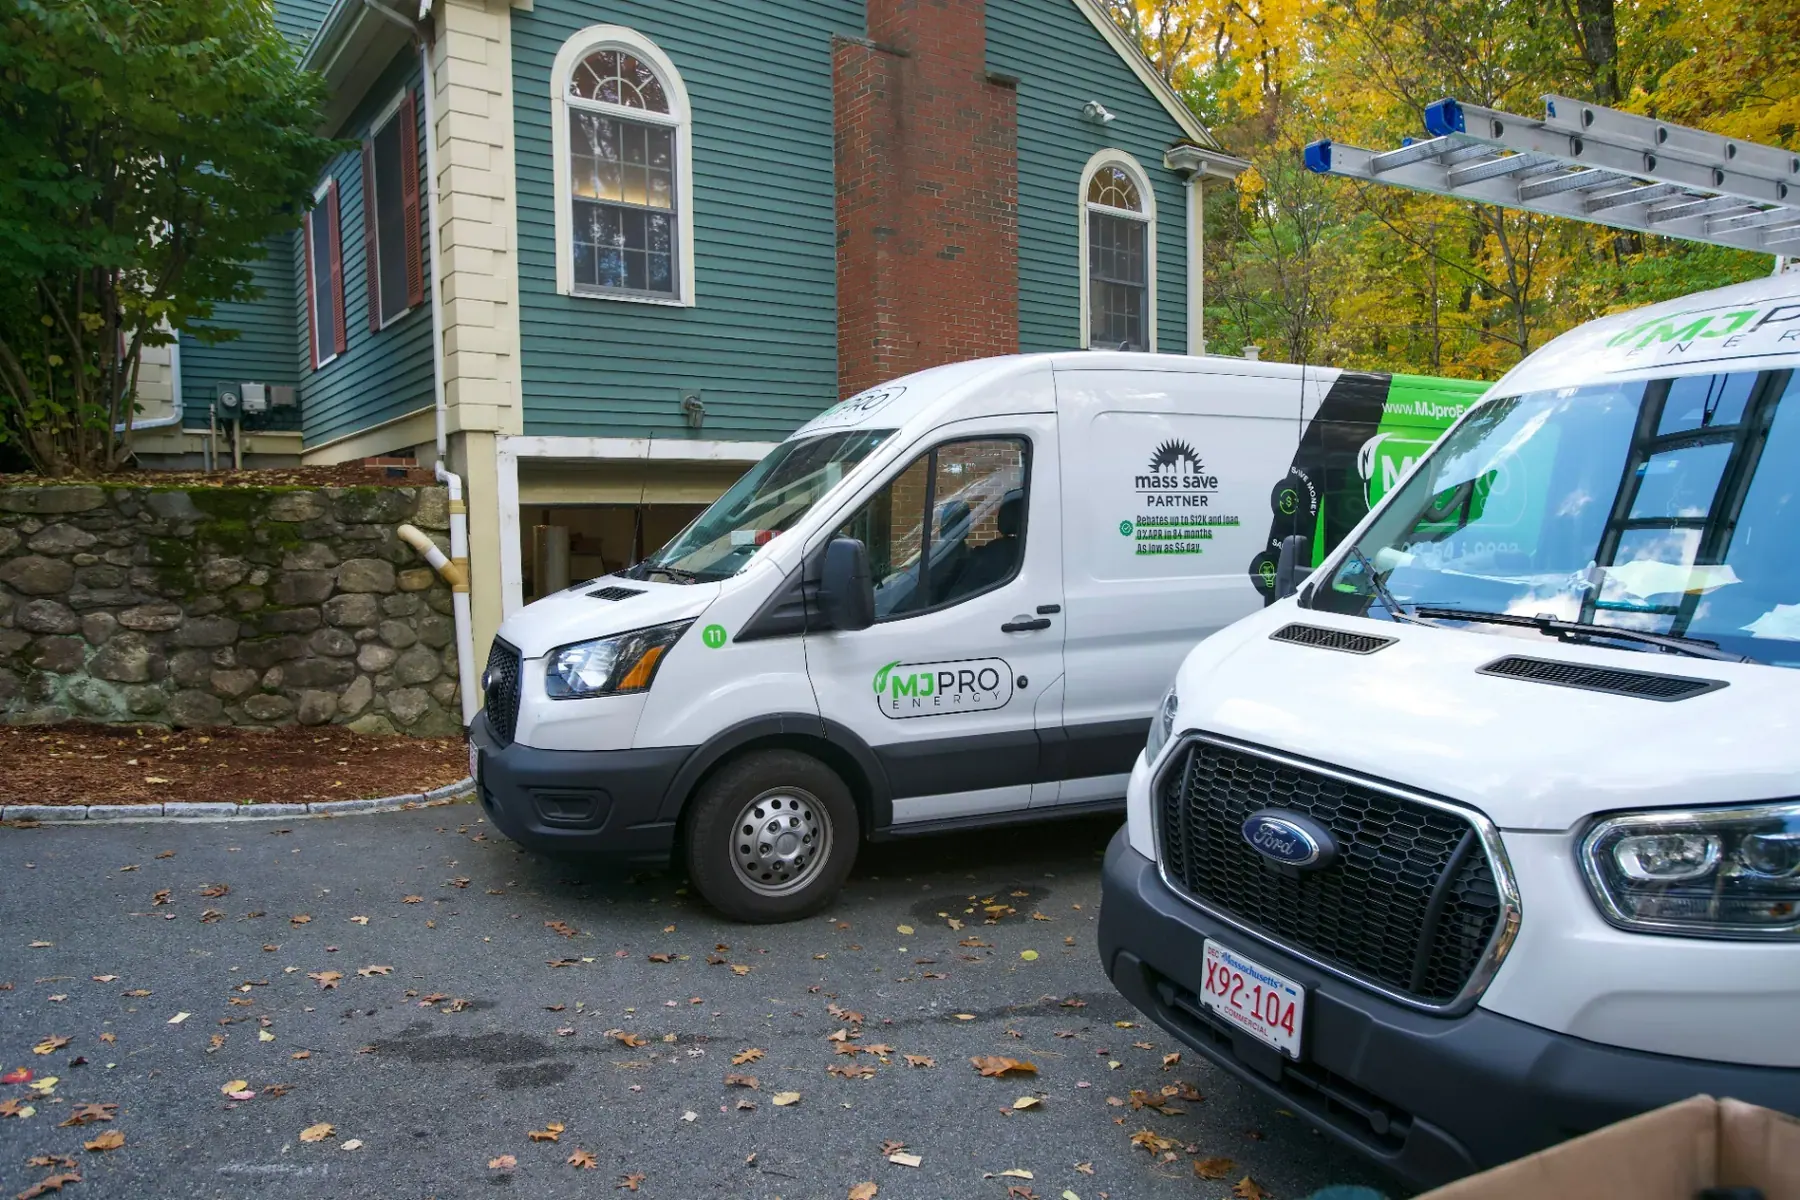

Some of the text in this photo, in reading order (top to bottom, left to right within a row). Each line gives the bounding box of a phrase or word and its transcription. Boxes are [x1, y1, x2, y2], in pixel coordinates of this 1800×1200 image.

[1381, 401, 1468, 420] www.MJproE
[1135, 475, 1219, 489] mass save
[1291, 466, 1317, 516] SAVE MONEY
[1147, 495, 1209, 507] PARTNER
[1136, 514, 1239, 526] Rebates up to $12K and loan
[1164, 529, 1172, 539] in
[1173, 529, 1183, 540] 84
[1184, 528, 1213, 539] months
[1137, 542, 1200, 554] As low as $5 day
[1272, 538, 1284, 549] SA
[707, 629, 721, 643] 11
[892, 691, 1001, 710] ENERGY
[1252, 823, 1297, 857] Ford
[1221, 951, 1279, 989] Massachusetts
[1224, 1006, 1268, 1037] COMMERCIAL
